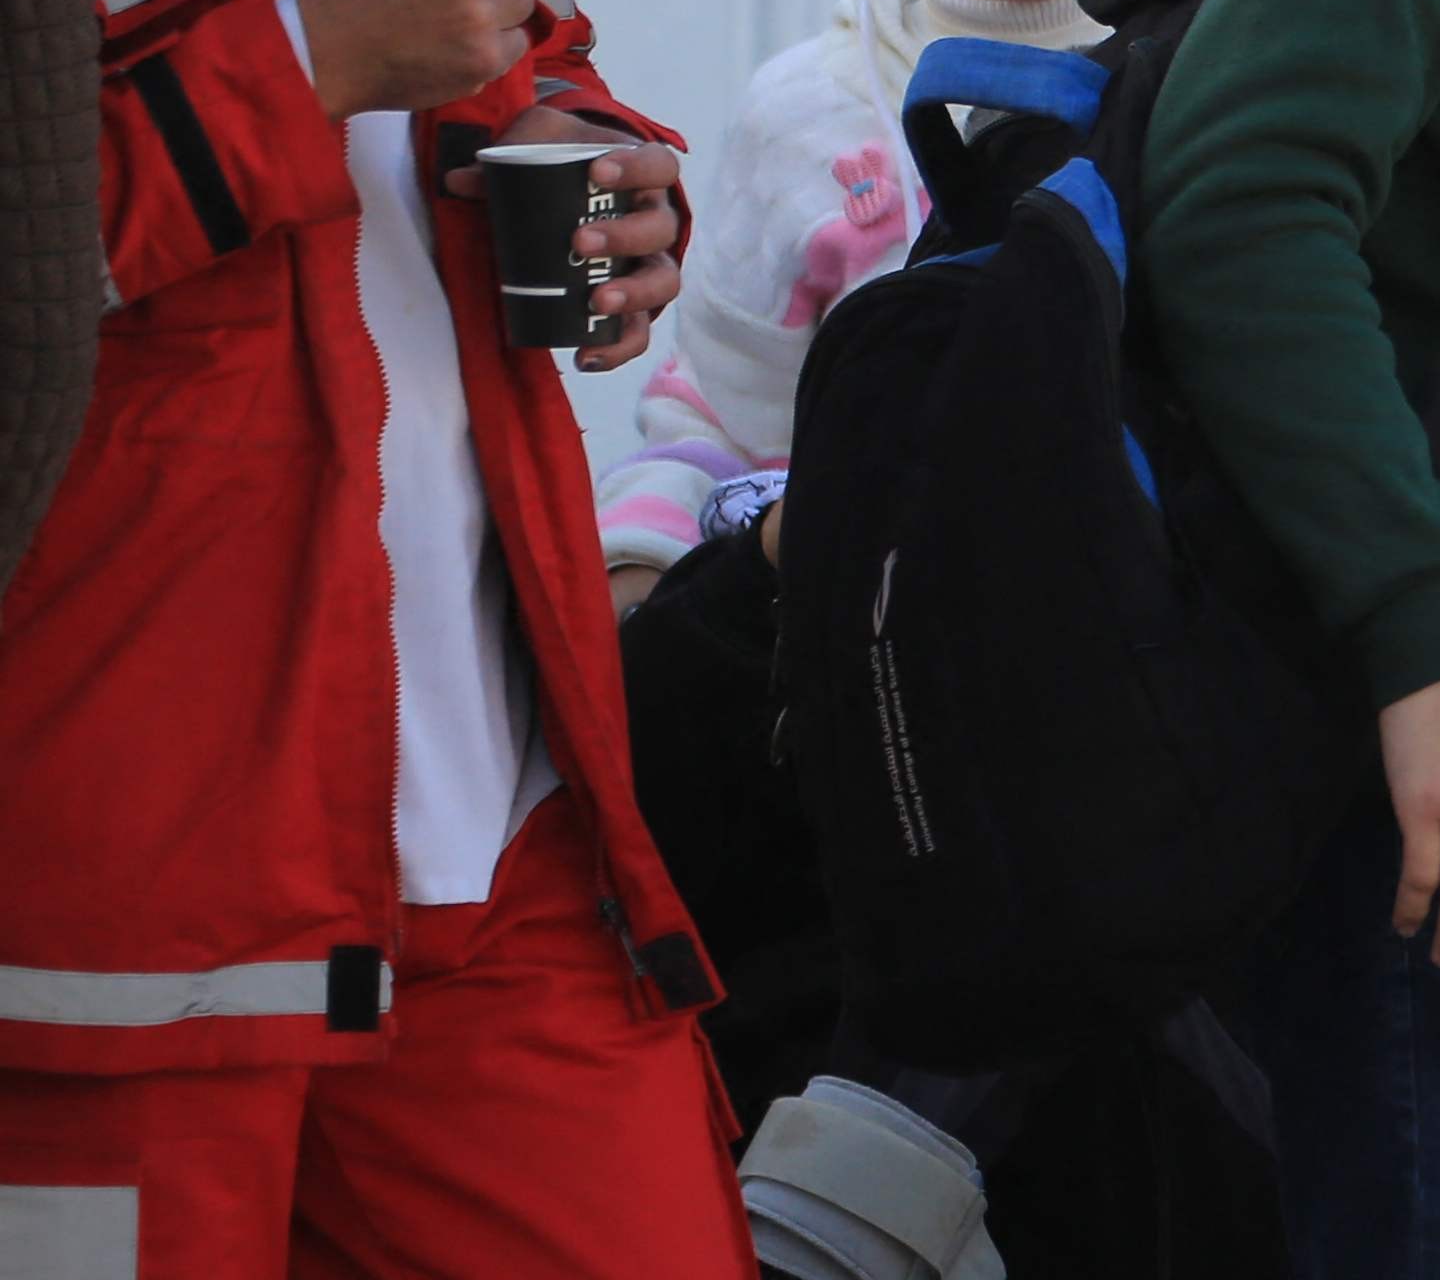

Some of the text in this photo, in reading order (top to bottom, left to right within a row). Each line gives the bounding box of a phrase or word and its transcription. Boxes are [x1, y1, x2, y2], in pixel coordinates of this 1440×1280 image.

[885, 640, 935, 852] University College of Applied Sciences
